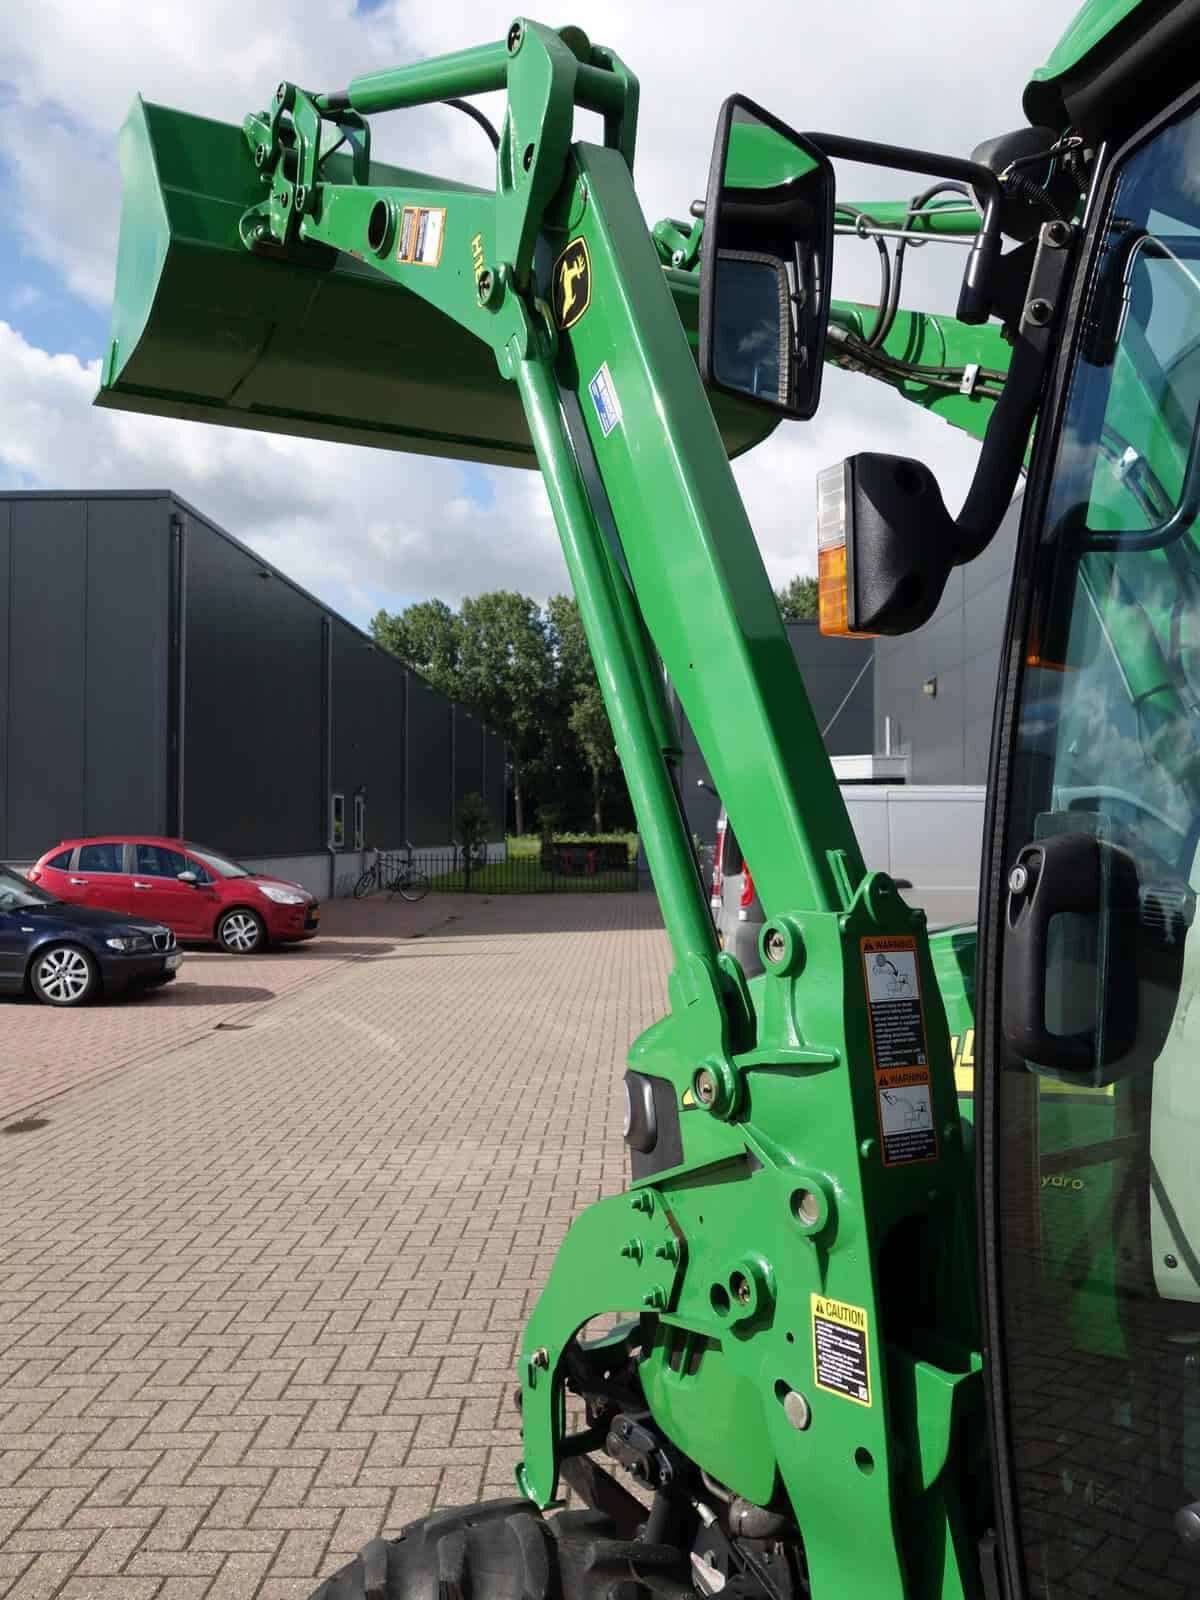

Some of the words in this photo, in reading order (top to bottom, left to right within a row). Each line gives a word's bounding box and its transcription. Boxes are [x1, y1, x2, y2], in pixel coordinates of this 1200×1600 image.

[875, 939, 914, 950] WARNING
[889, 1071, 929, 1084] WARNING
[1040, 1175, 1086, 1191] ydro
[826, 1302, 864, 1327] CAUTION
